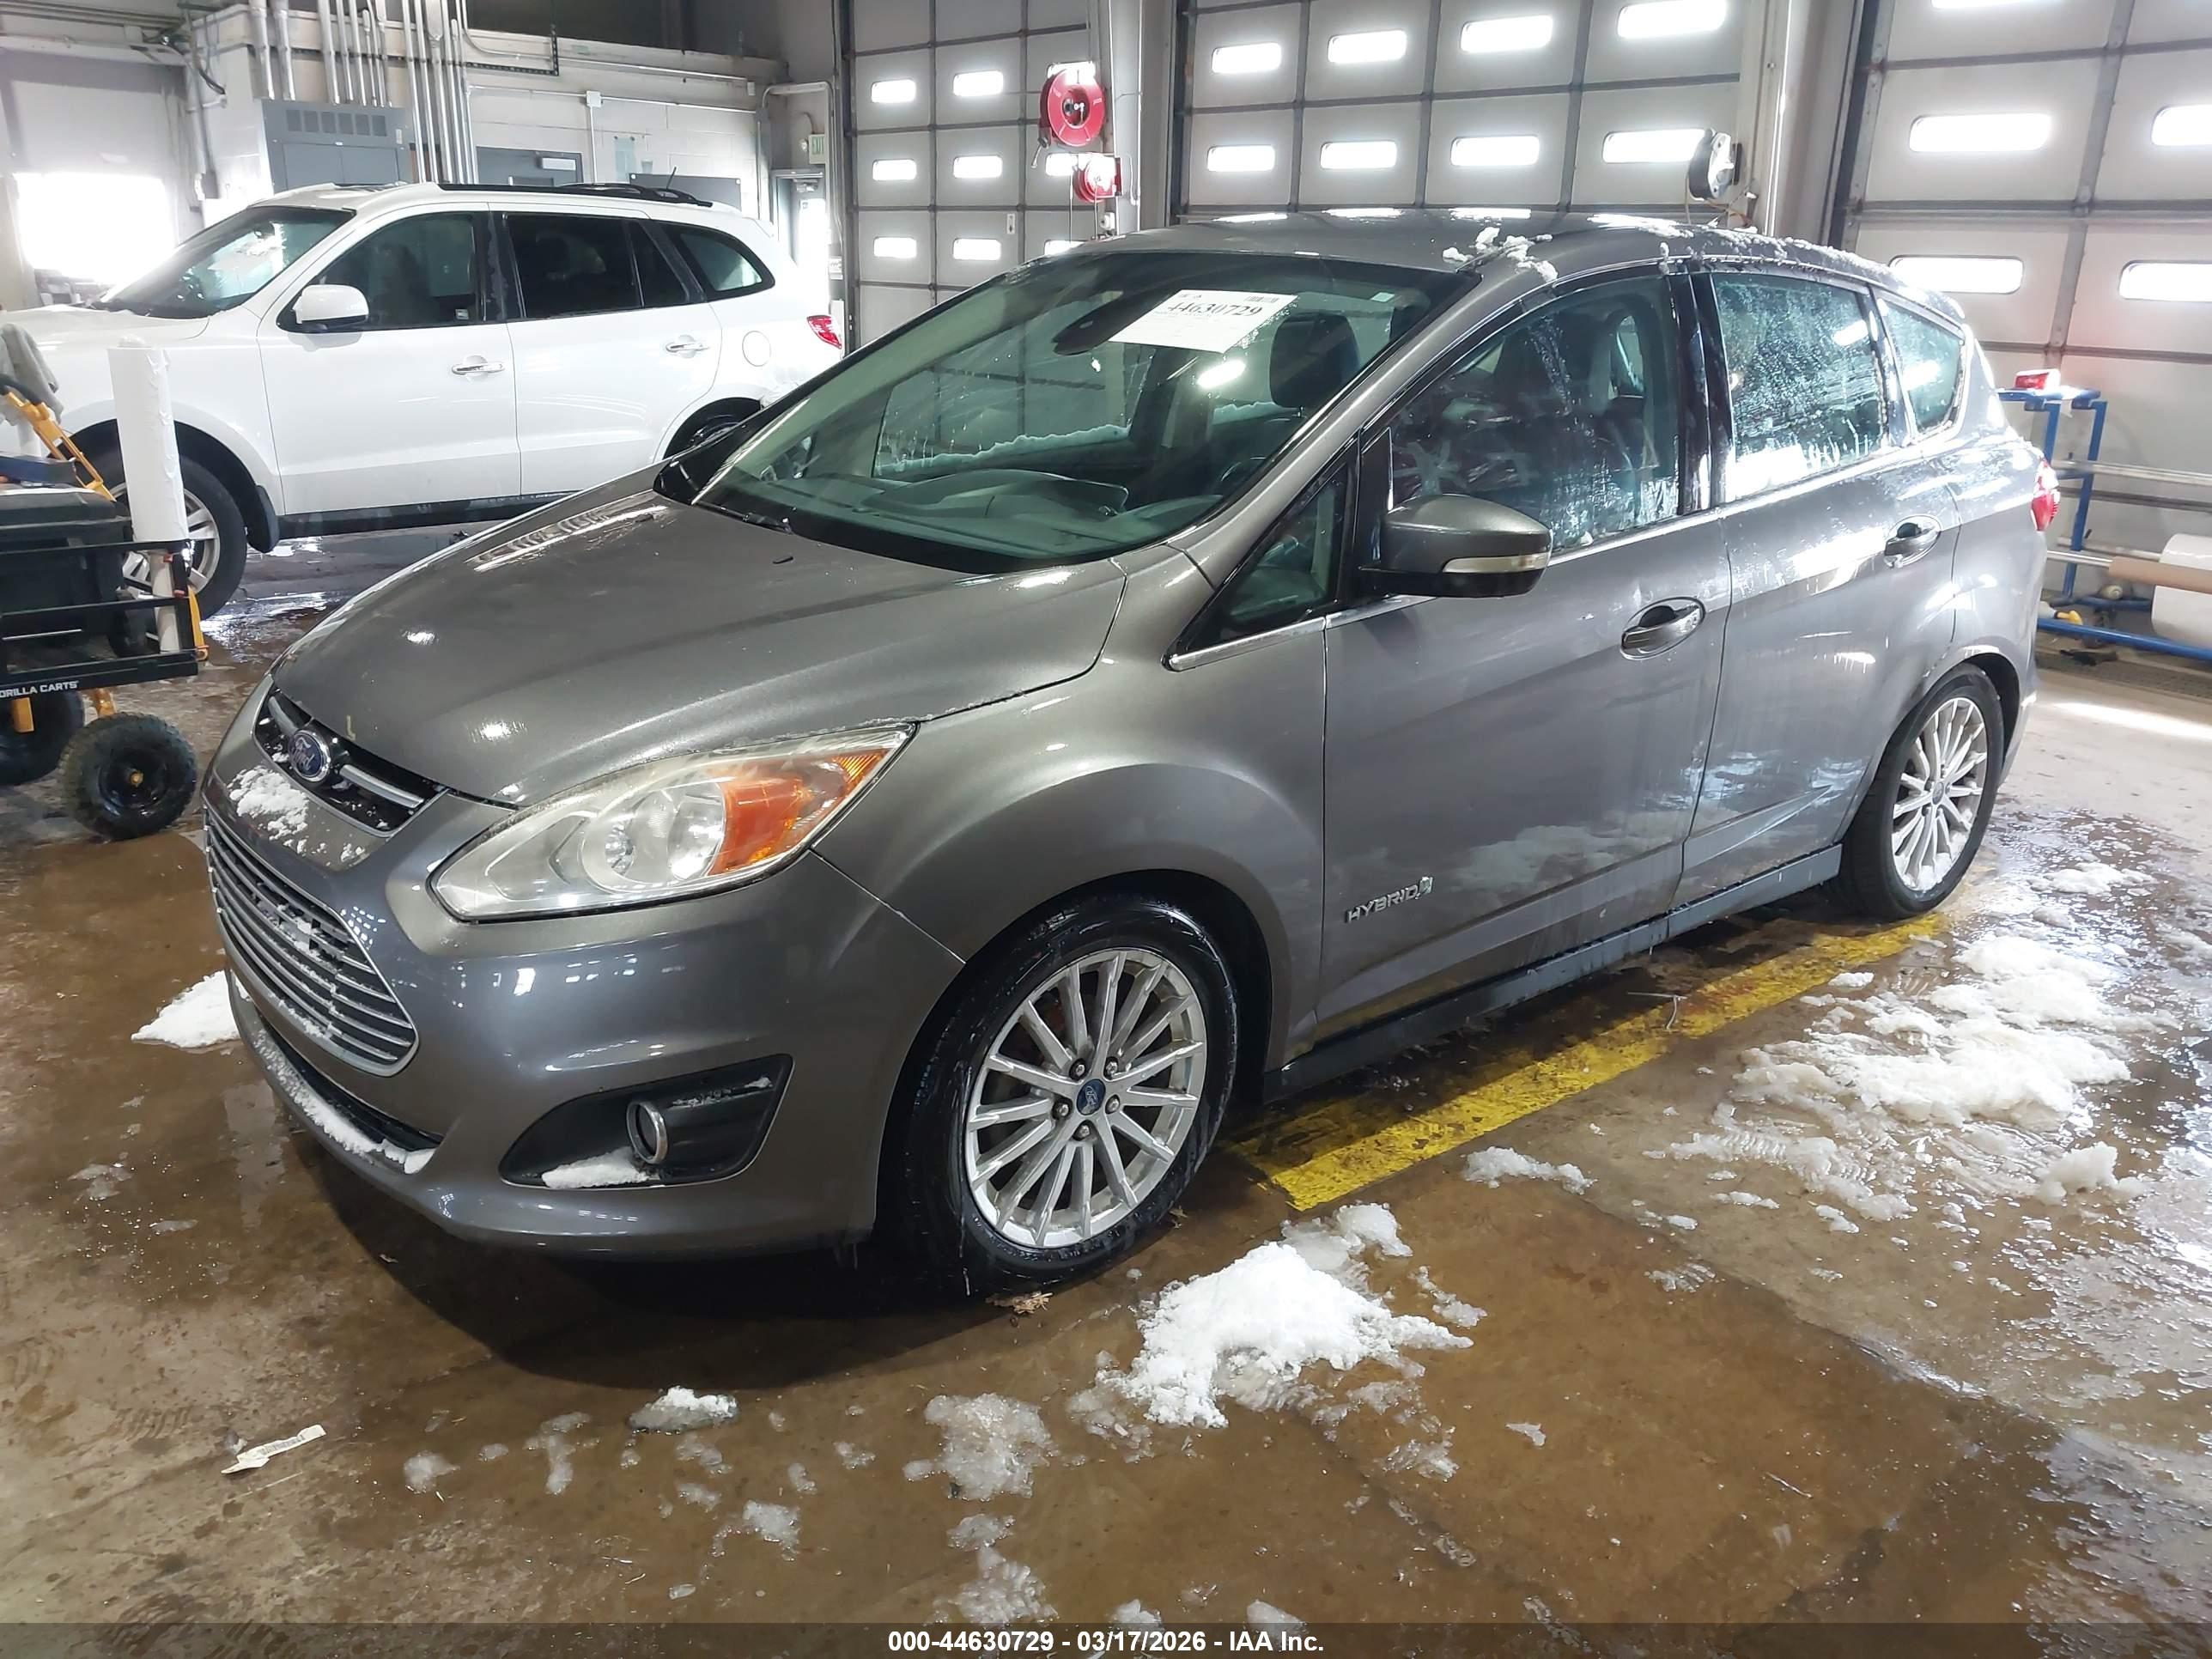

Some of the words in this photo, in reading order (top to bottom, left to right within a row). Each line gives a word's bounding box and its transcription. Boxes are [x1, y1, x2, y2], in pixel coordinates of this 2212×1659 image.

[811, 137, 824, 155] EXIT
[1168, 302, 1261, 316] 44630729
[40, 681, 78, 692] CARTS
[1346, 884, 1419, 922] HYBRID
